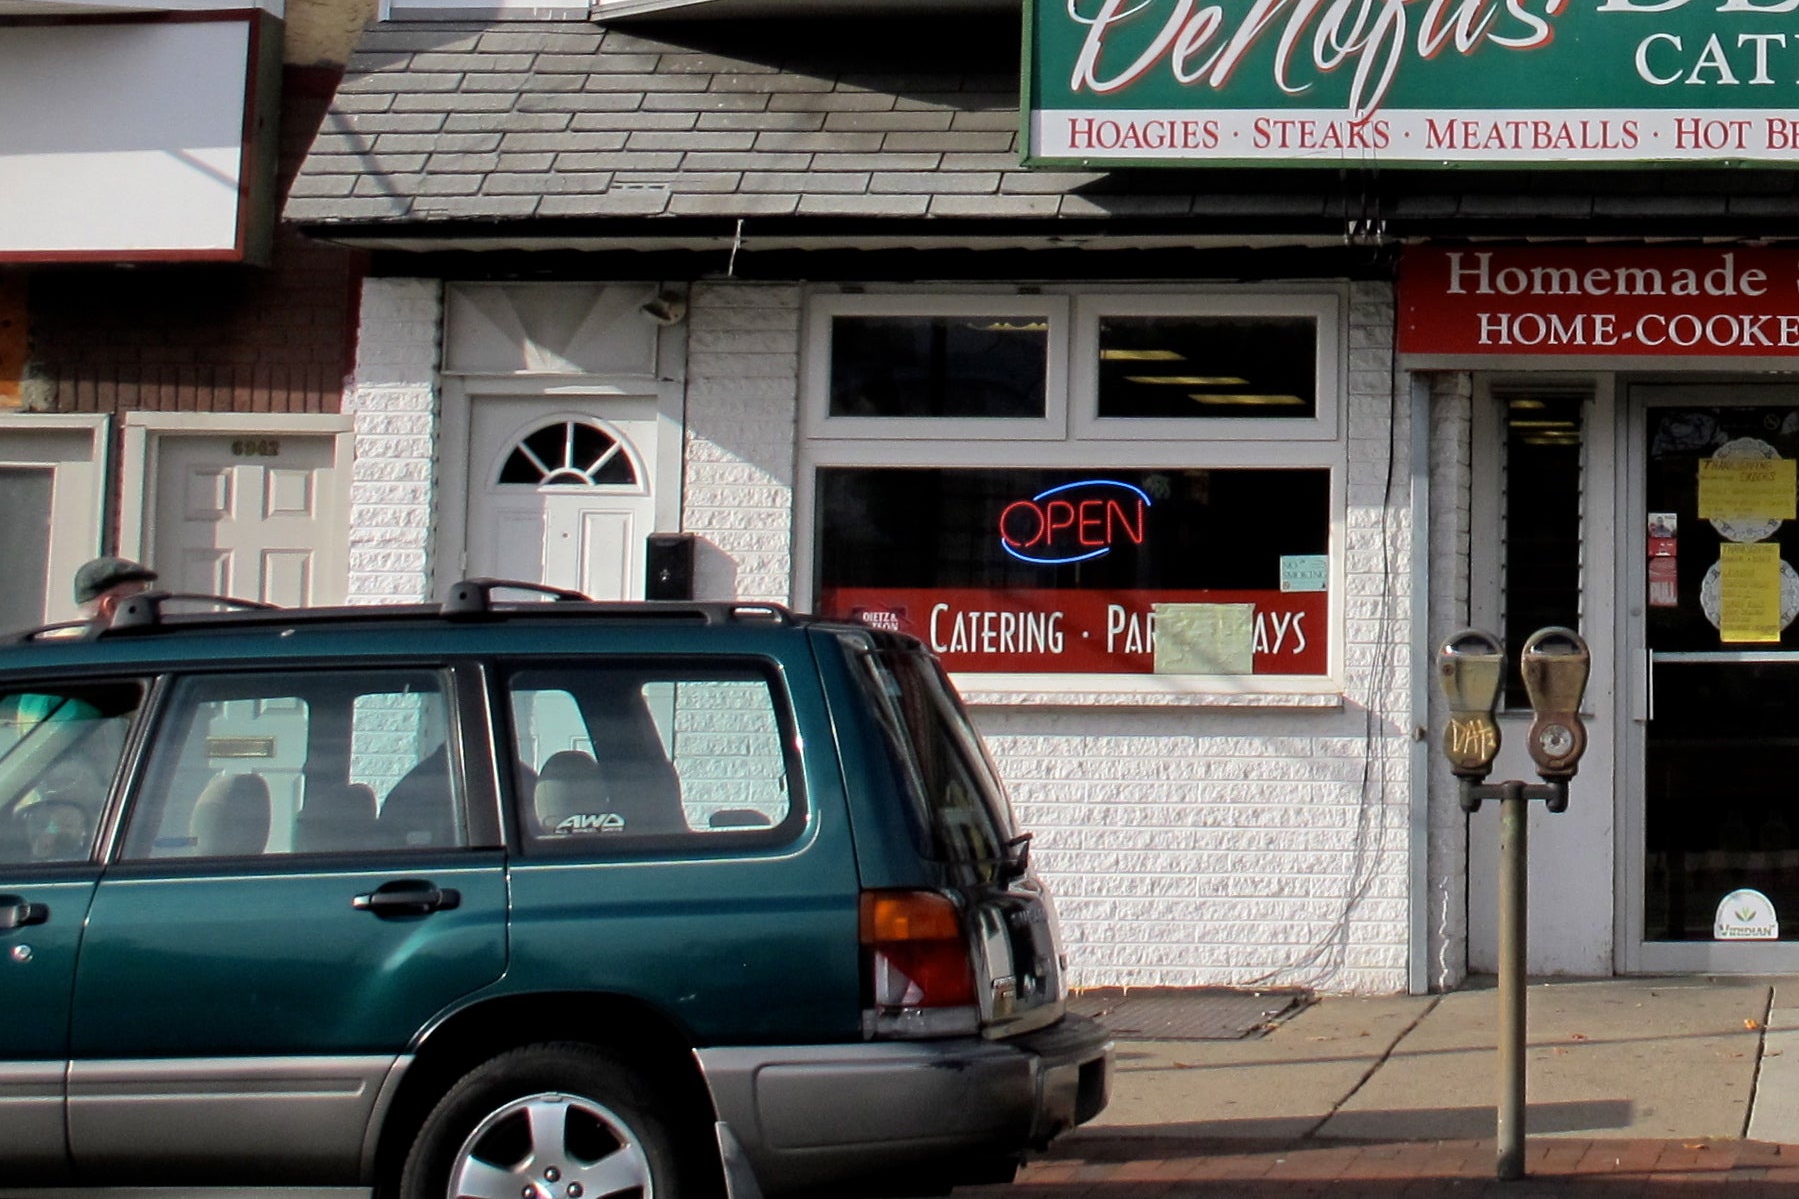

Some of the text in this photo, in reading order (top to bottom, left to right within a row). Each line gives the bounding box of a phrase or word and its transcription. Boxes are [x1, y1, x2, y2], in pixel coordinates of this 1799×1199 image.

[1068, 117, 1220, 150] HOAGIES
[1252, 117, 1391, 150] STEAKS
[1424, 118, 1639, 150] MEATBALLS
[1674, 118, 1752, 151] HOT
[1445, 251, 1768, 297] Homemade
[1000, 499, 1143, 547] OPEN
[929, 603, 1064, 655] CATERING
[556, 813, 625, 828] AWD
[1719, 924, 1773, 937] VIRIDIAN
